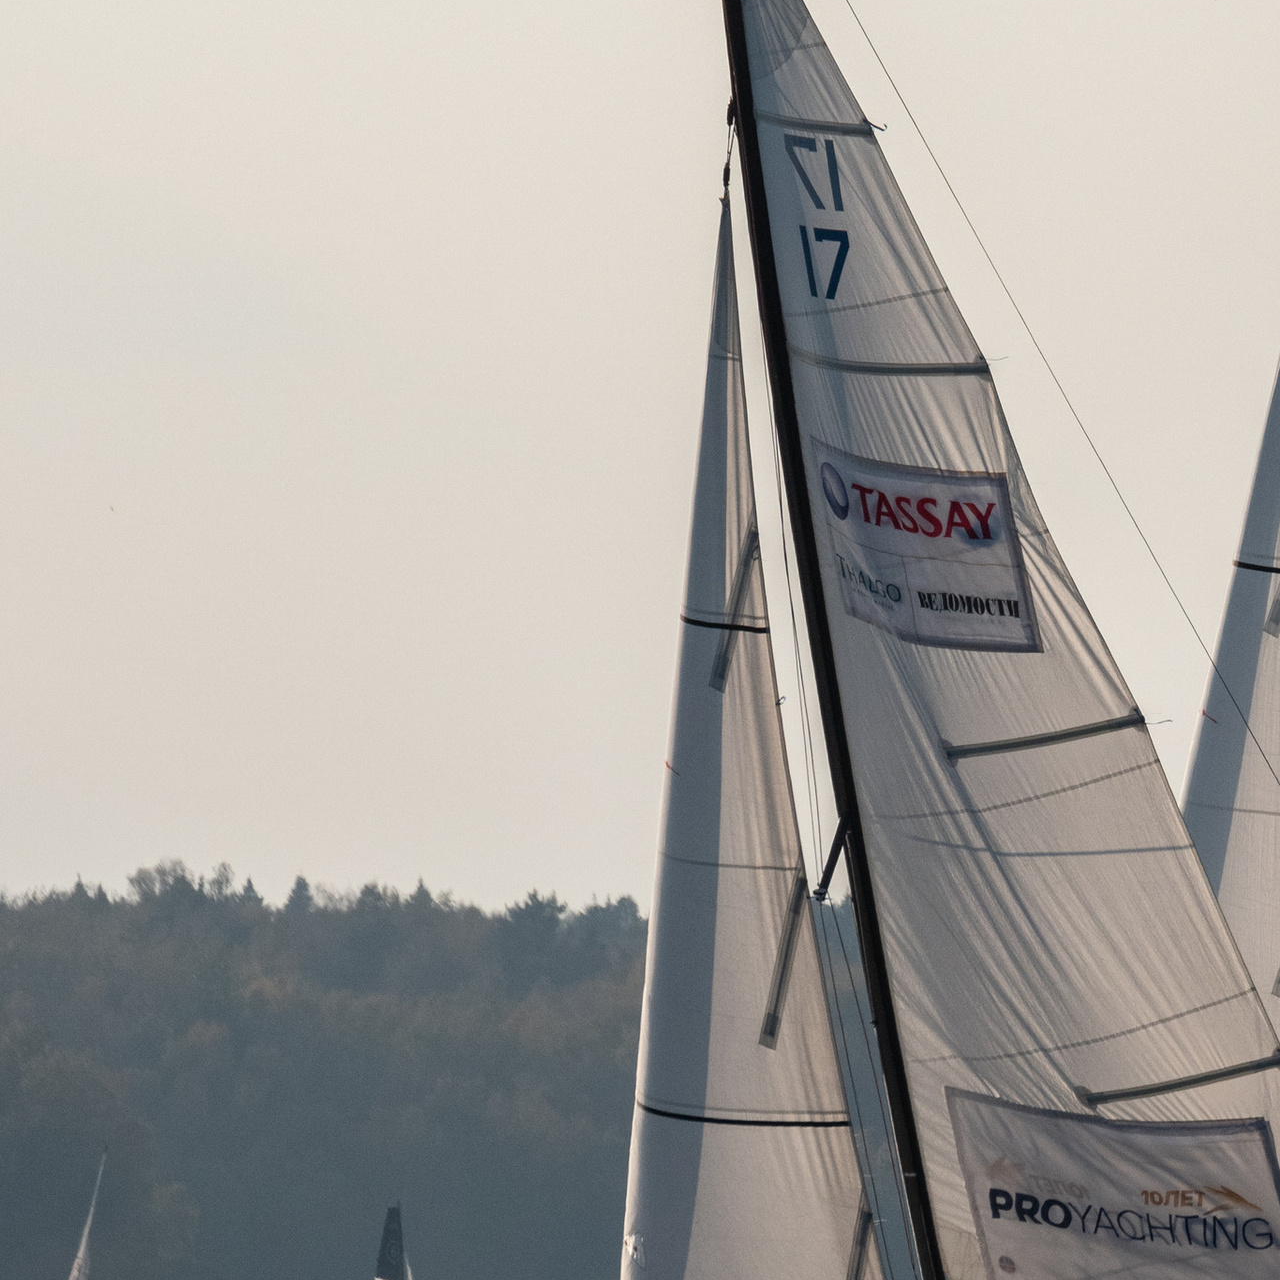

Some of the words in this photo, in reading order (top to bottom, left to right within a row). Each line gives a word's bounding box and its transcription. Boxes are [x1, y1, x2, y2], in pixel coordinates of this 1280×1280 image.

[799, 224, 850, 301] 17
[850, 482, 997, 541] TASSAY
[835, 552, 902, 603] THALGO
[988, 1187, 1275, 1251] PROYACHTING
